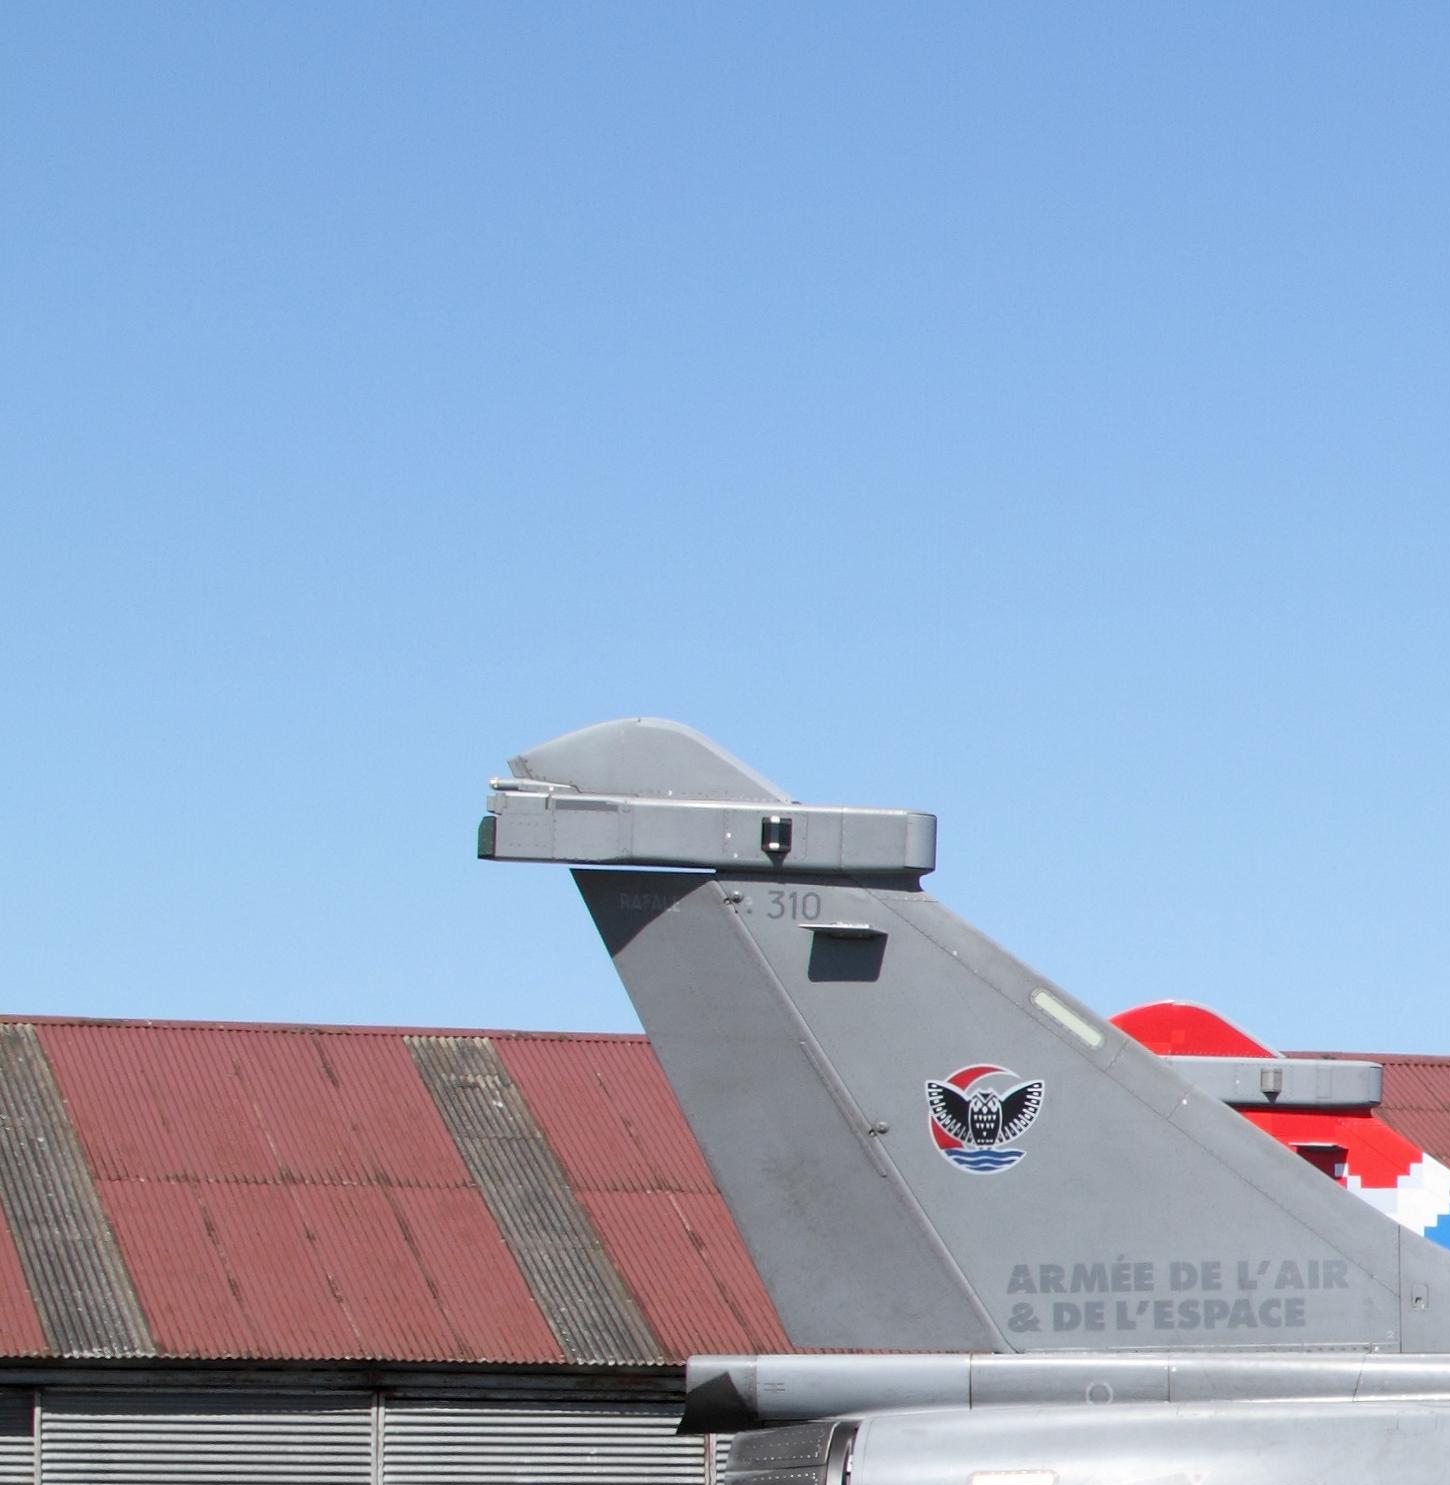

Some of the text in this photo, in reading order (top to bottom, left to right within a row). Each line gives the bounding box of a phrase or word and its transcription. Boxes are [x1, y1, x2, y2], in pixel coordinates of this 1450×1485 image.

[767, 890, 822, 921] 310
[1006, 1253, 1350, 1295] ARMÉE DE L'AIR
[1007, 1297, 1307, 1334] & DE L'ESPACE
